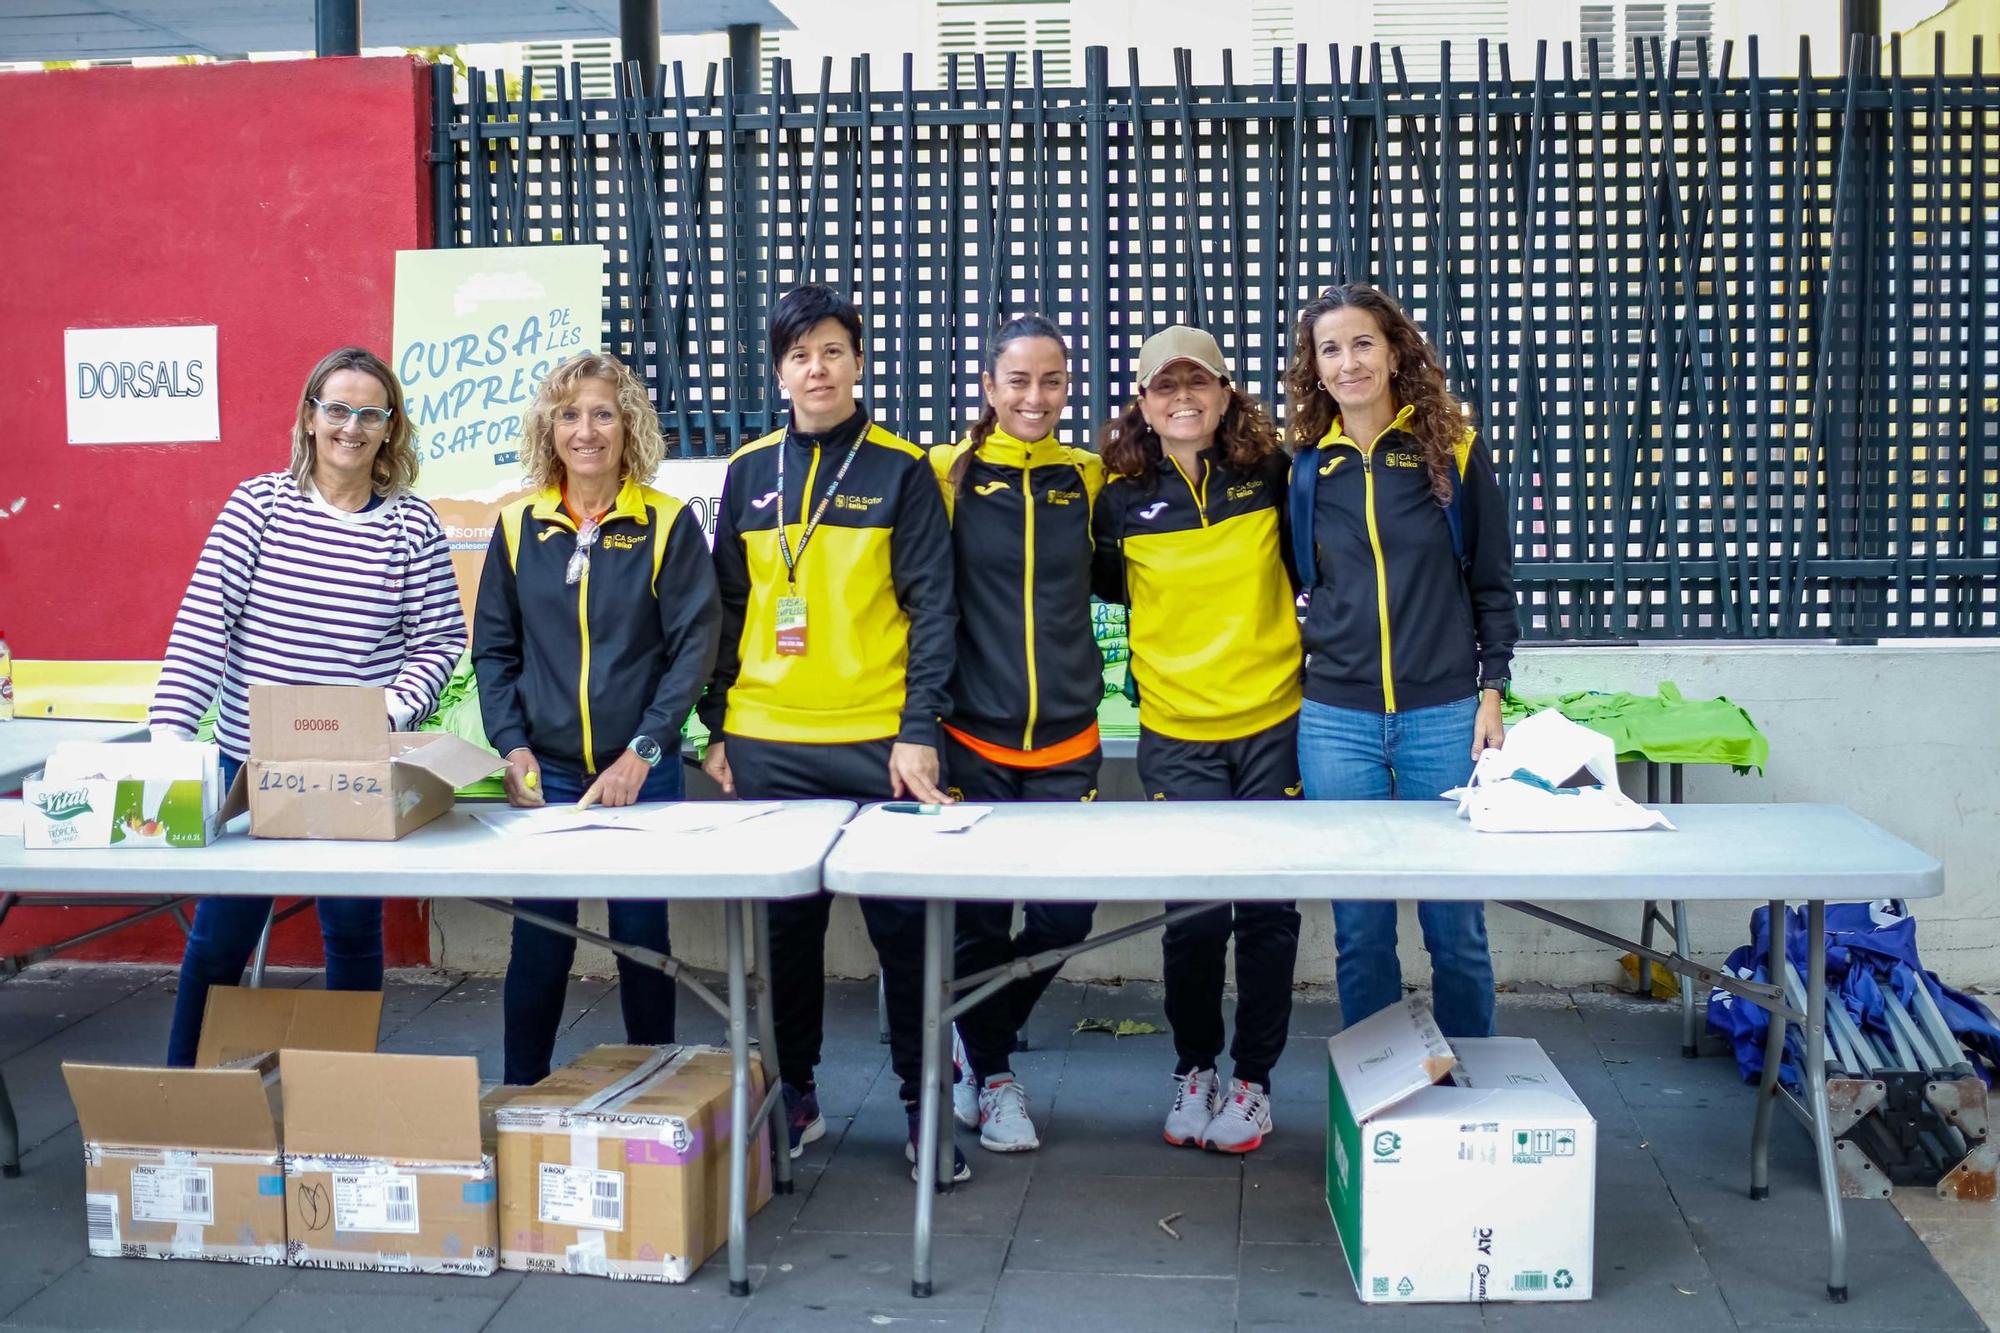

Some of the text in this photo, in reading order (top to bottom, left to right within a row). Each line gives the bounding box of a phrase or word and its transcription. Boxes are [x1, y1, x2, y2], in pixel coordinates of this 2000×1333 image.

[400, 308, 571, 386] CURSA DE
[546, 327, 582, 351] LES
[78, 359, 204, 399] DORSALS
[294, 719, 340, 731] 090086
[258, 770, 306, 793] 1201
[329, 773, 383, 792] 1362
[39, 787, 89, 812] Vital
[1511, 1156, 1543, 1164] FRAGILE
